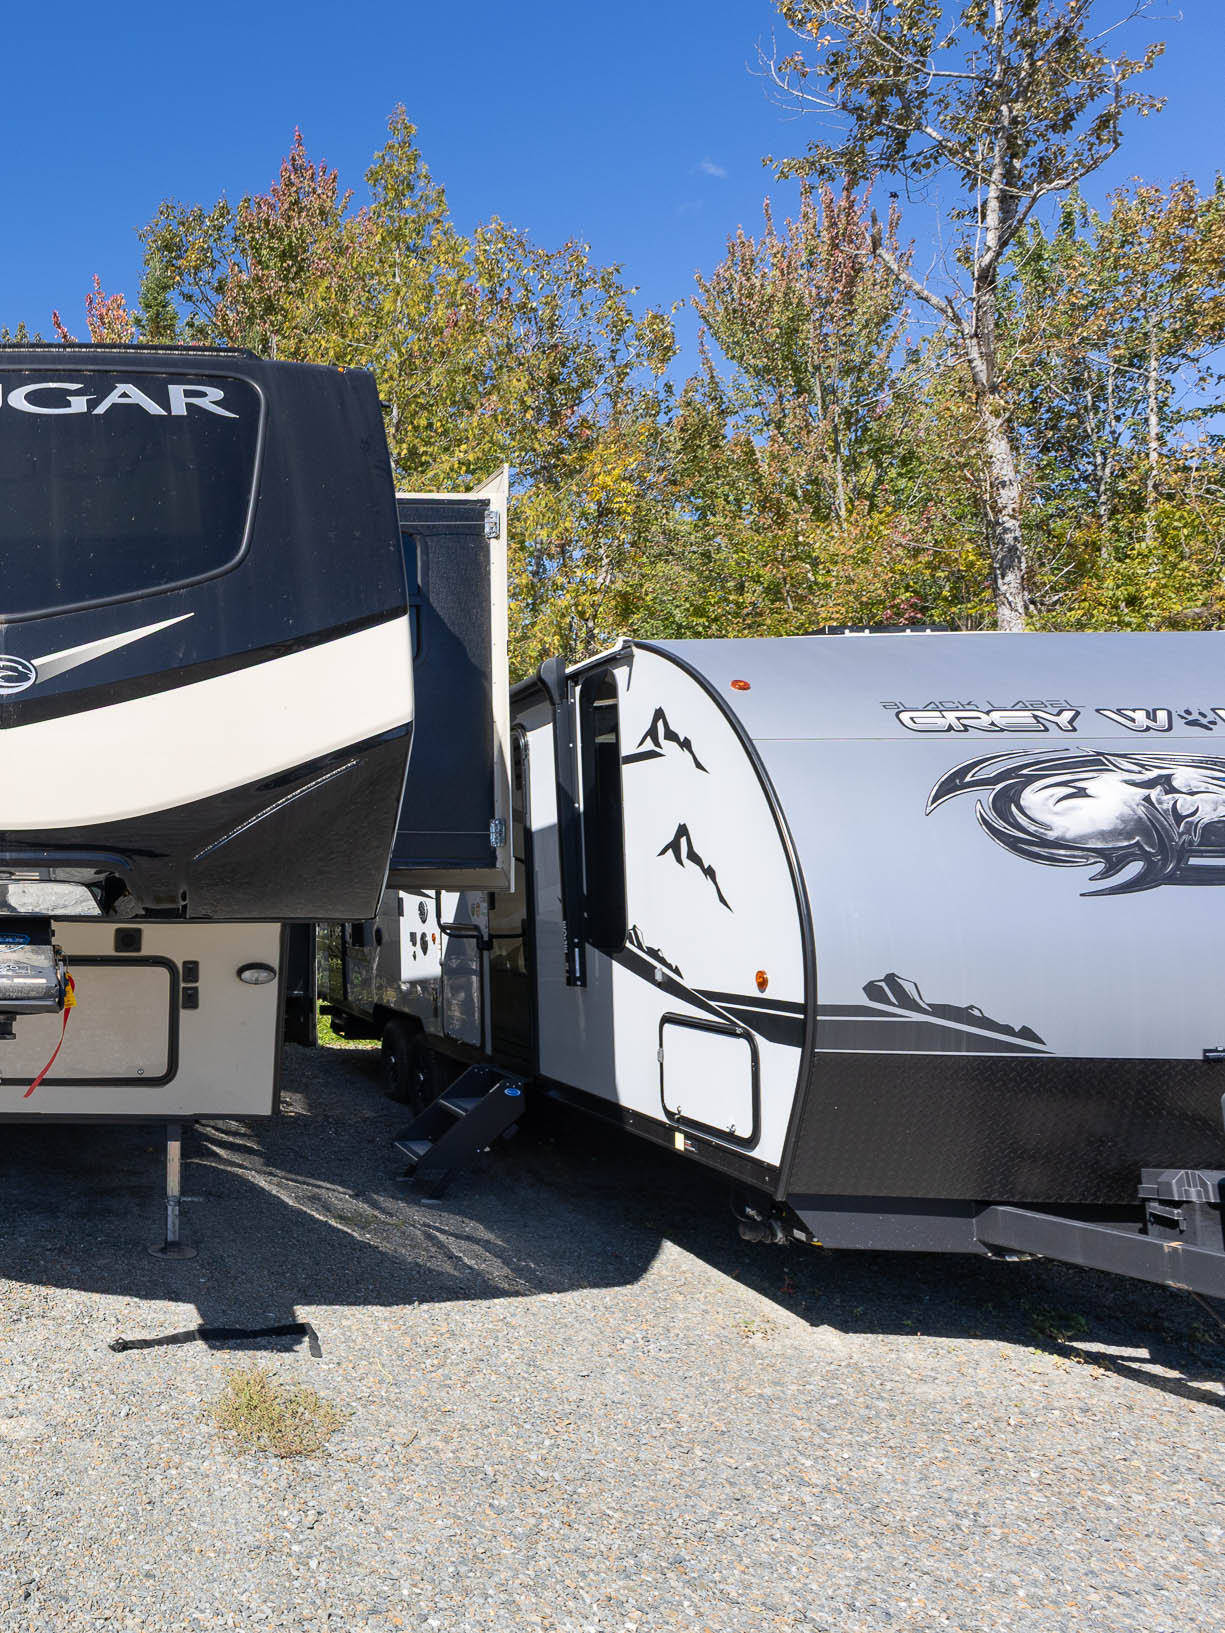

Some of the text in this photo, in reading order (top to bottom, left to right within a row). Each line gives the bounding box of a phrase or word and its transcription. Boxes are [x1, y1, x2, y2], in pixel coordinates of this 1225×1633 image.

[880, 699, 1086, 710] BLACK LABEL
[895, 708, 1080, 733] GREY
